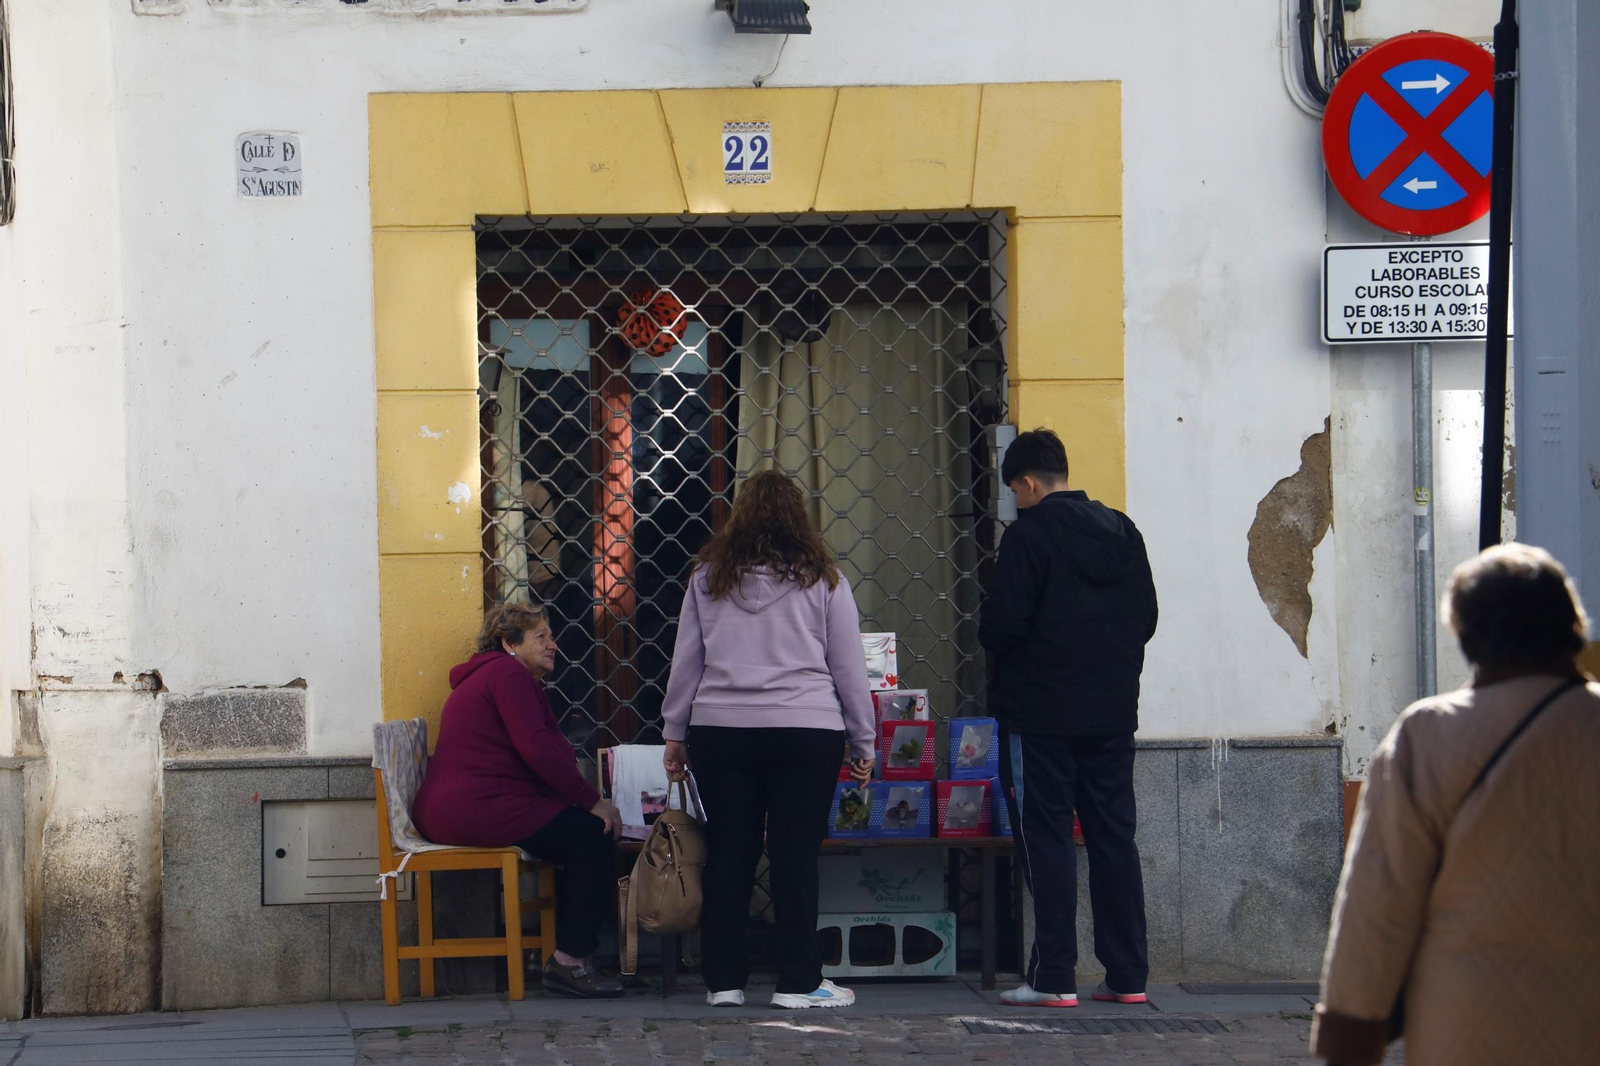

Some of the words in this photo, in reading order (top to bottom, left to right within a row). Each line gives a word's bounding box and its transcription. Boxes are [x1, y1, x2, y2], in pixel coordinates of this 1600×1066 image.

[241, 140, 275, 163] CALLE
[725, 135, 768, 170] 22
[1388, 250, 1463, 264] EXCEPTO
[1371, 266, 1481, 281] LABORABLES
[1355, 285, 1414, 299] CURSO
[1419, 283, 1489, 298] ESCOLA
[1344, 305, 1366, 318] DE
[1370, 304, 1410, 317] 08:15
[1415, 304, 1426, 316] H
[1434, 303, 1445, 316] A
[1449, 303, 1488, 316] 09:15
[1346, 322, 1357, 334] Y
[1361, 321, 1383, 334] DE
[1388, 320, 1427, 334] 13:30
[1430, 320, 1442, 333] A
[1446, 319, 1485, 332] 15:30
[875, 894, 921, 903] Orchids
[853, 915, 891, 923] Orchids
